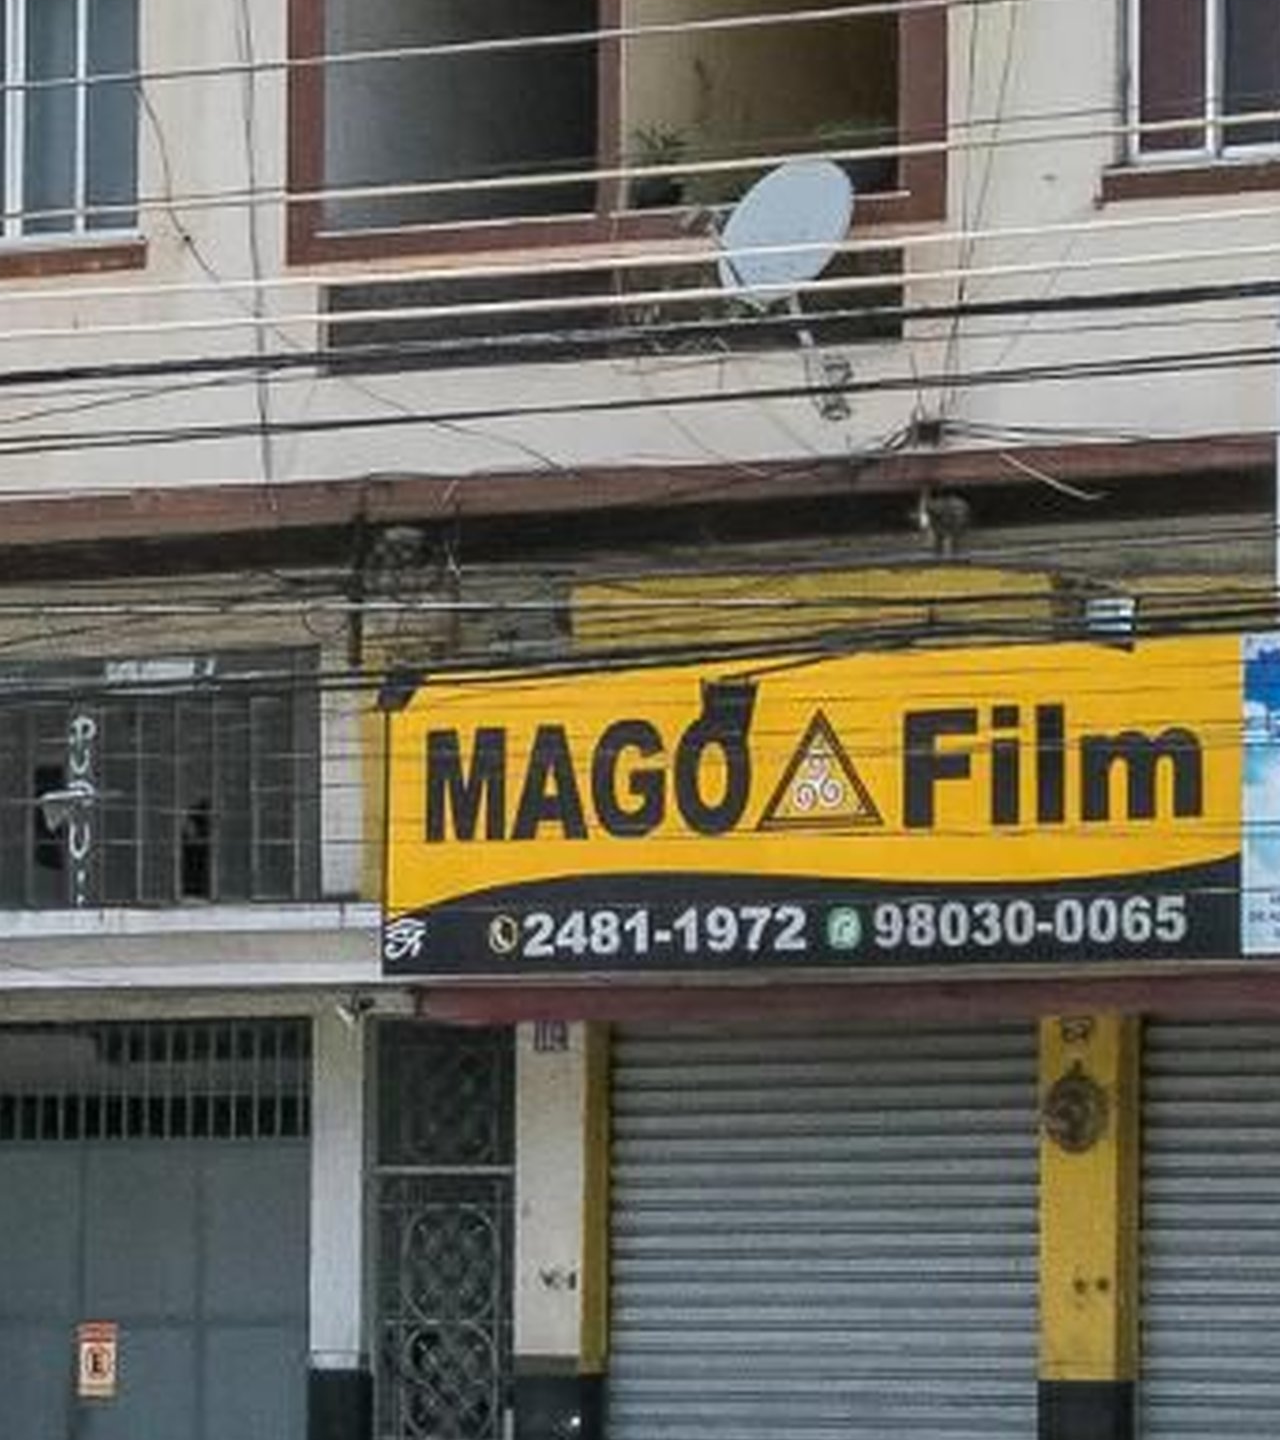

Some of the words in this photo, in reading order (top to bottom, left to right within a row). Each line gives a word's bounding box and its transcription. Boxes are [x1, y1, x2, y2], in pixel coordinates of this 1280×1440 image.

[425, 718, 753, 843] MAGO
[902, 702, 1204, 827] Film
[523, 906, 807, 959] 2481-1972
[874, 895, 1187, 948] 98030-0065
